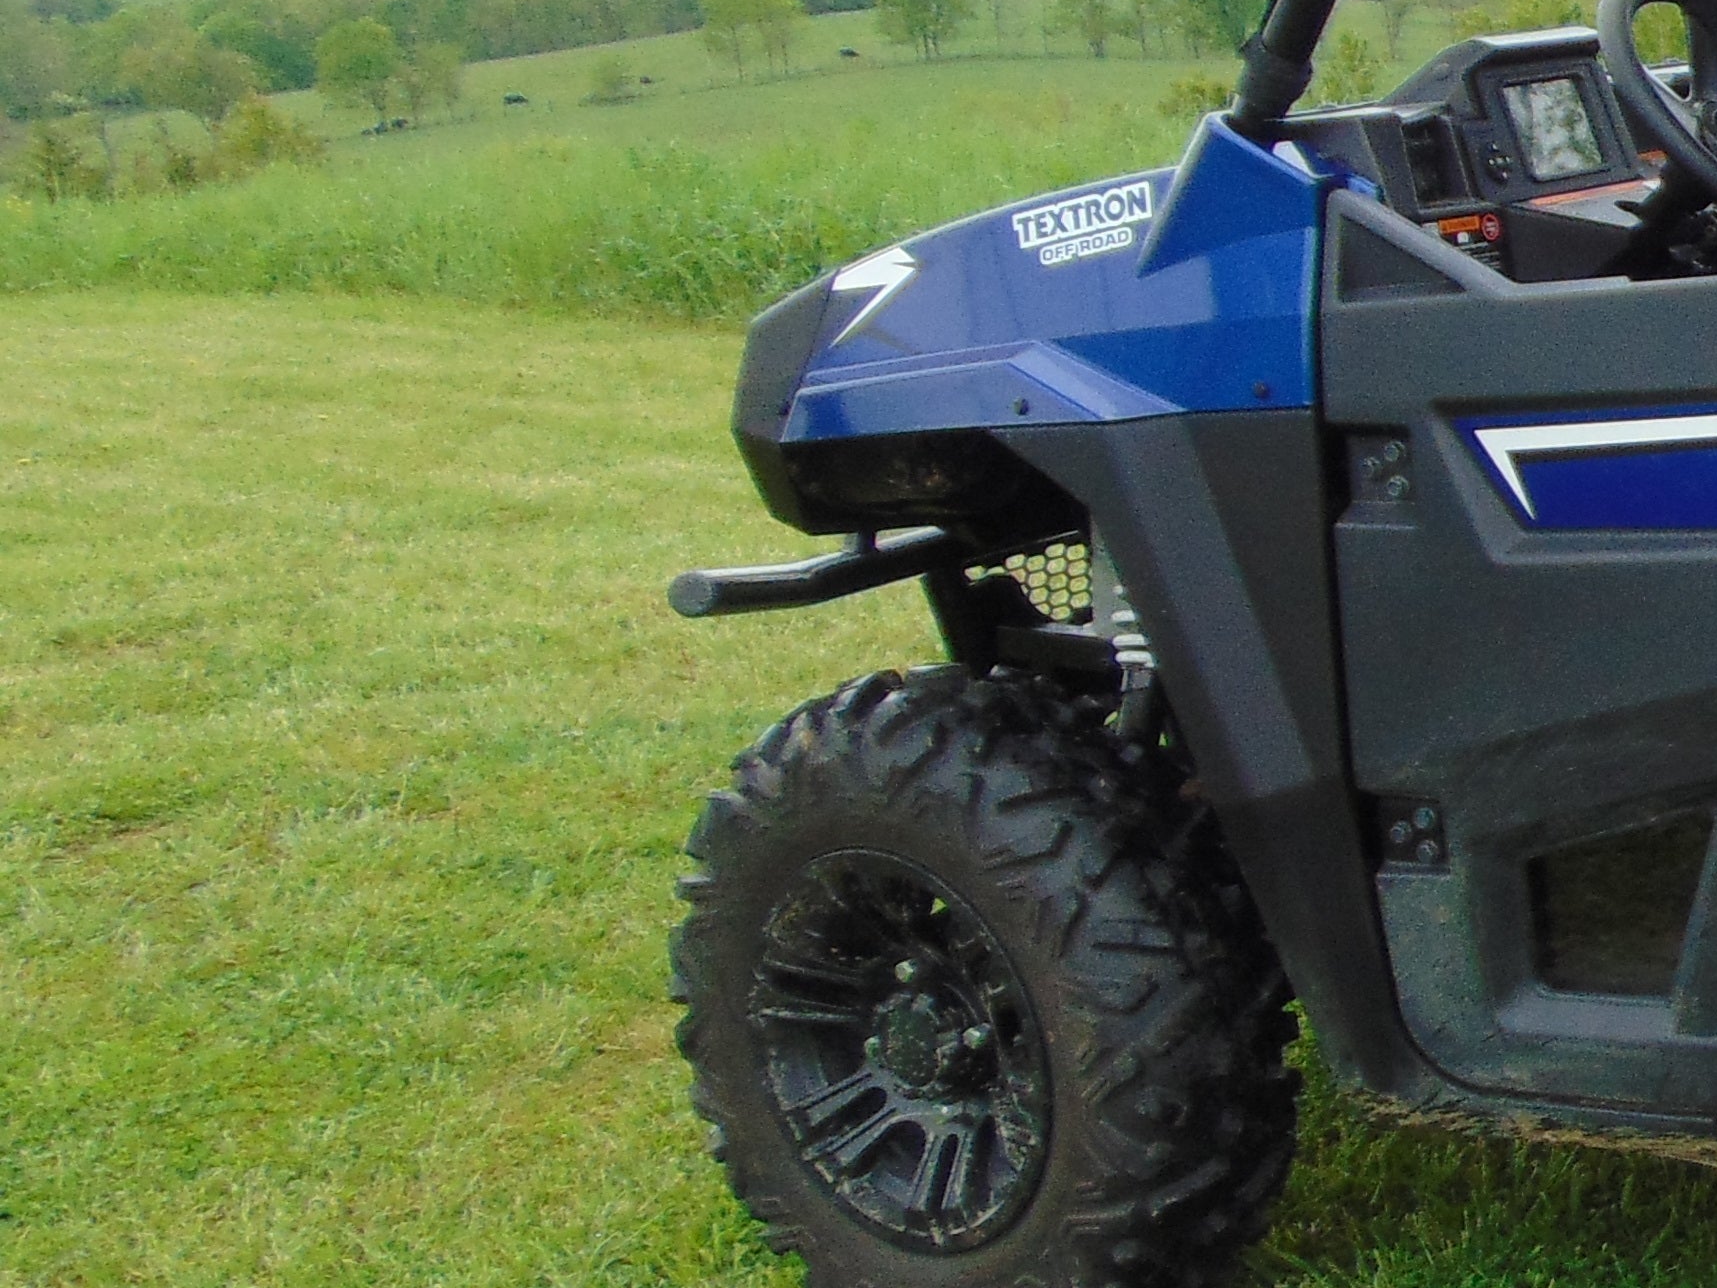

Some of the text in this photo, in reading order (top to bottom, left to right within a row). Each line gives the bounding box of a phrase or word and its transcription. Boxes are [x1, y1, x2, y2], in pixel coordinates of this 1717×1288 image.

[1016, 186, 1148, 244] TEXTRON
[1042, 230, 1130, 262] OFF ROAD
